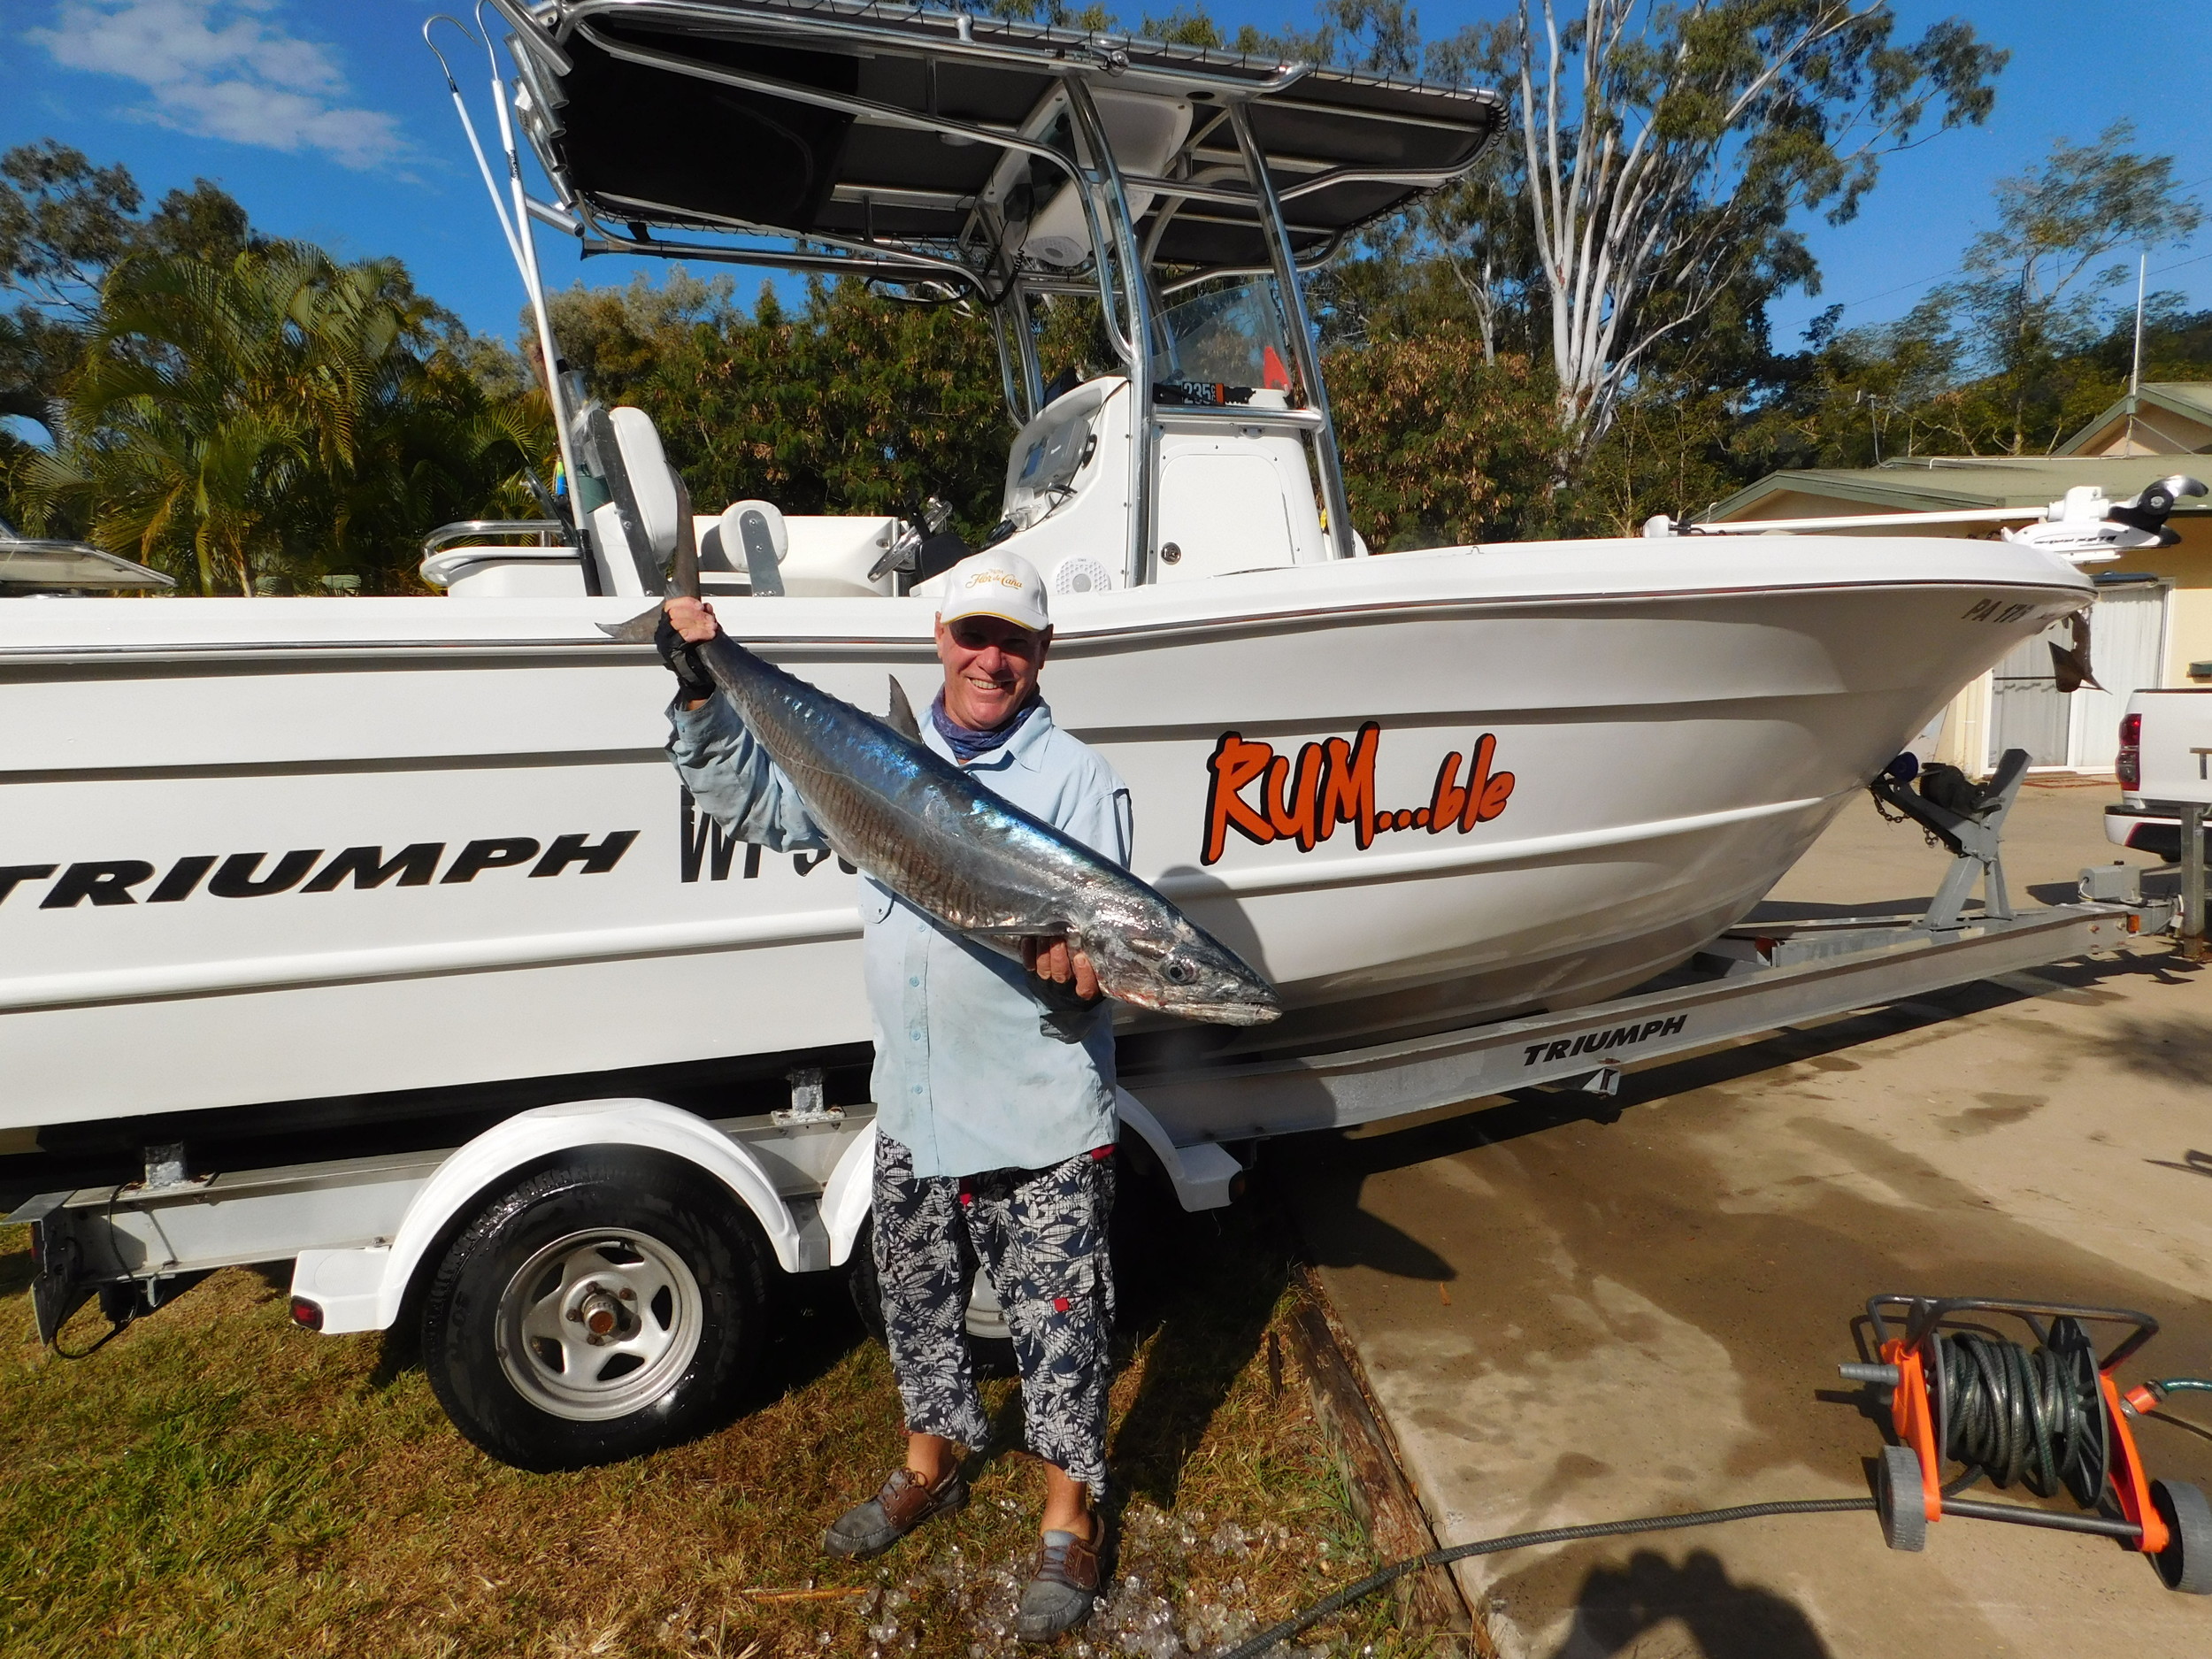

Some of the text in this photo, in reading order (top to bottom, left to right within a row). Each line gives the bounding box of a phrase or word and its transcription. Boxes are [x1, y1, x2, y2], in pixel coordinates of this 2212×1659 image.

[1184, 382, 1211, 404] 235
[965, 572, 991, 588] Flor
[1002, 573, 1023, 590] Caña
[1961, 598, 2002, 622] PA
[1200, 721, 1515, 866] RUM...ble
[0, 830, 641, 910] TRIUMPH
[1524, 1014, 1688, 1066] TRIUMPH
